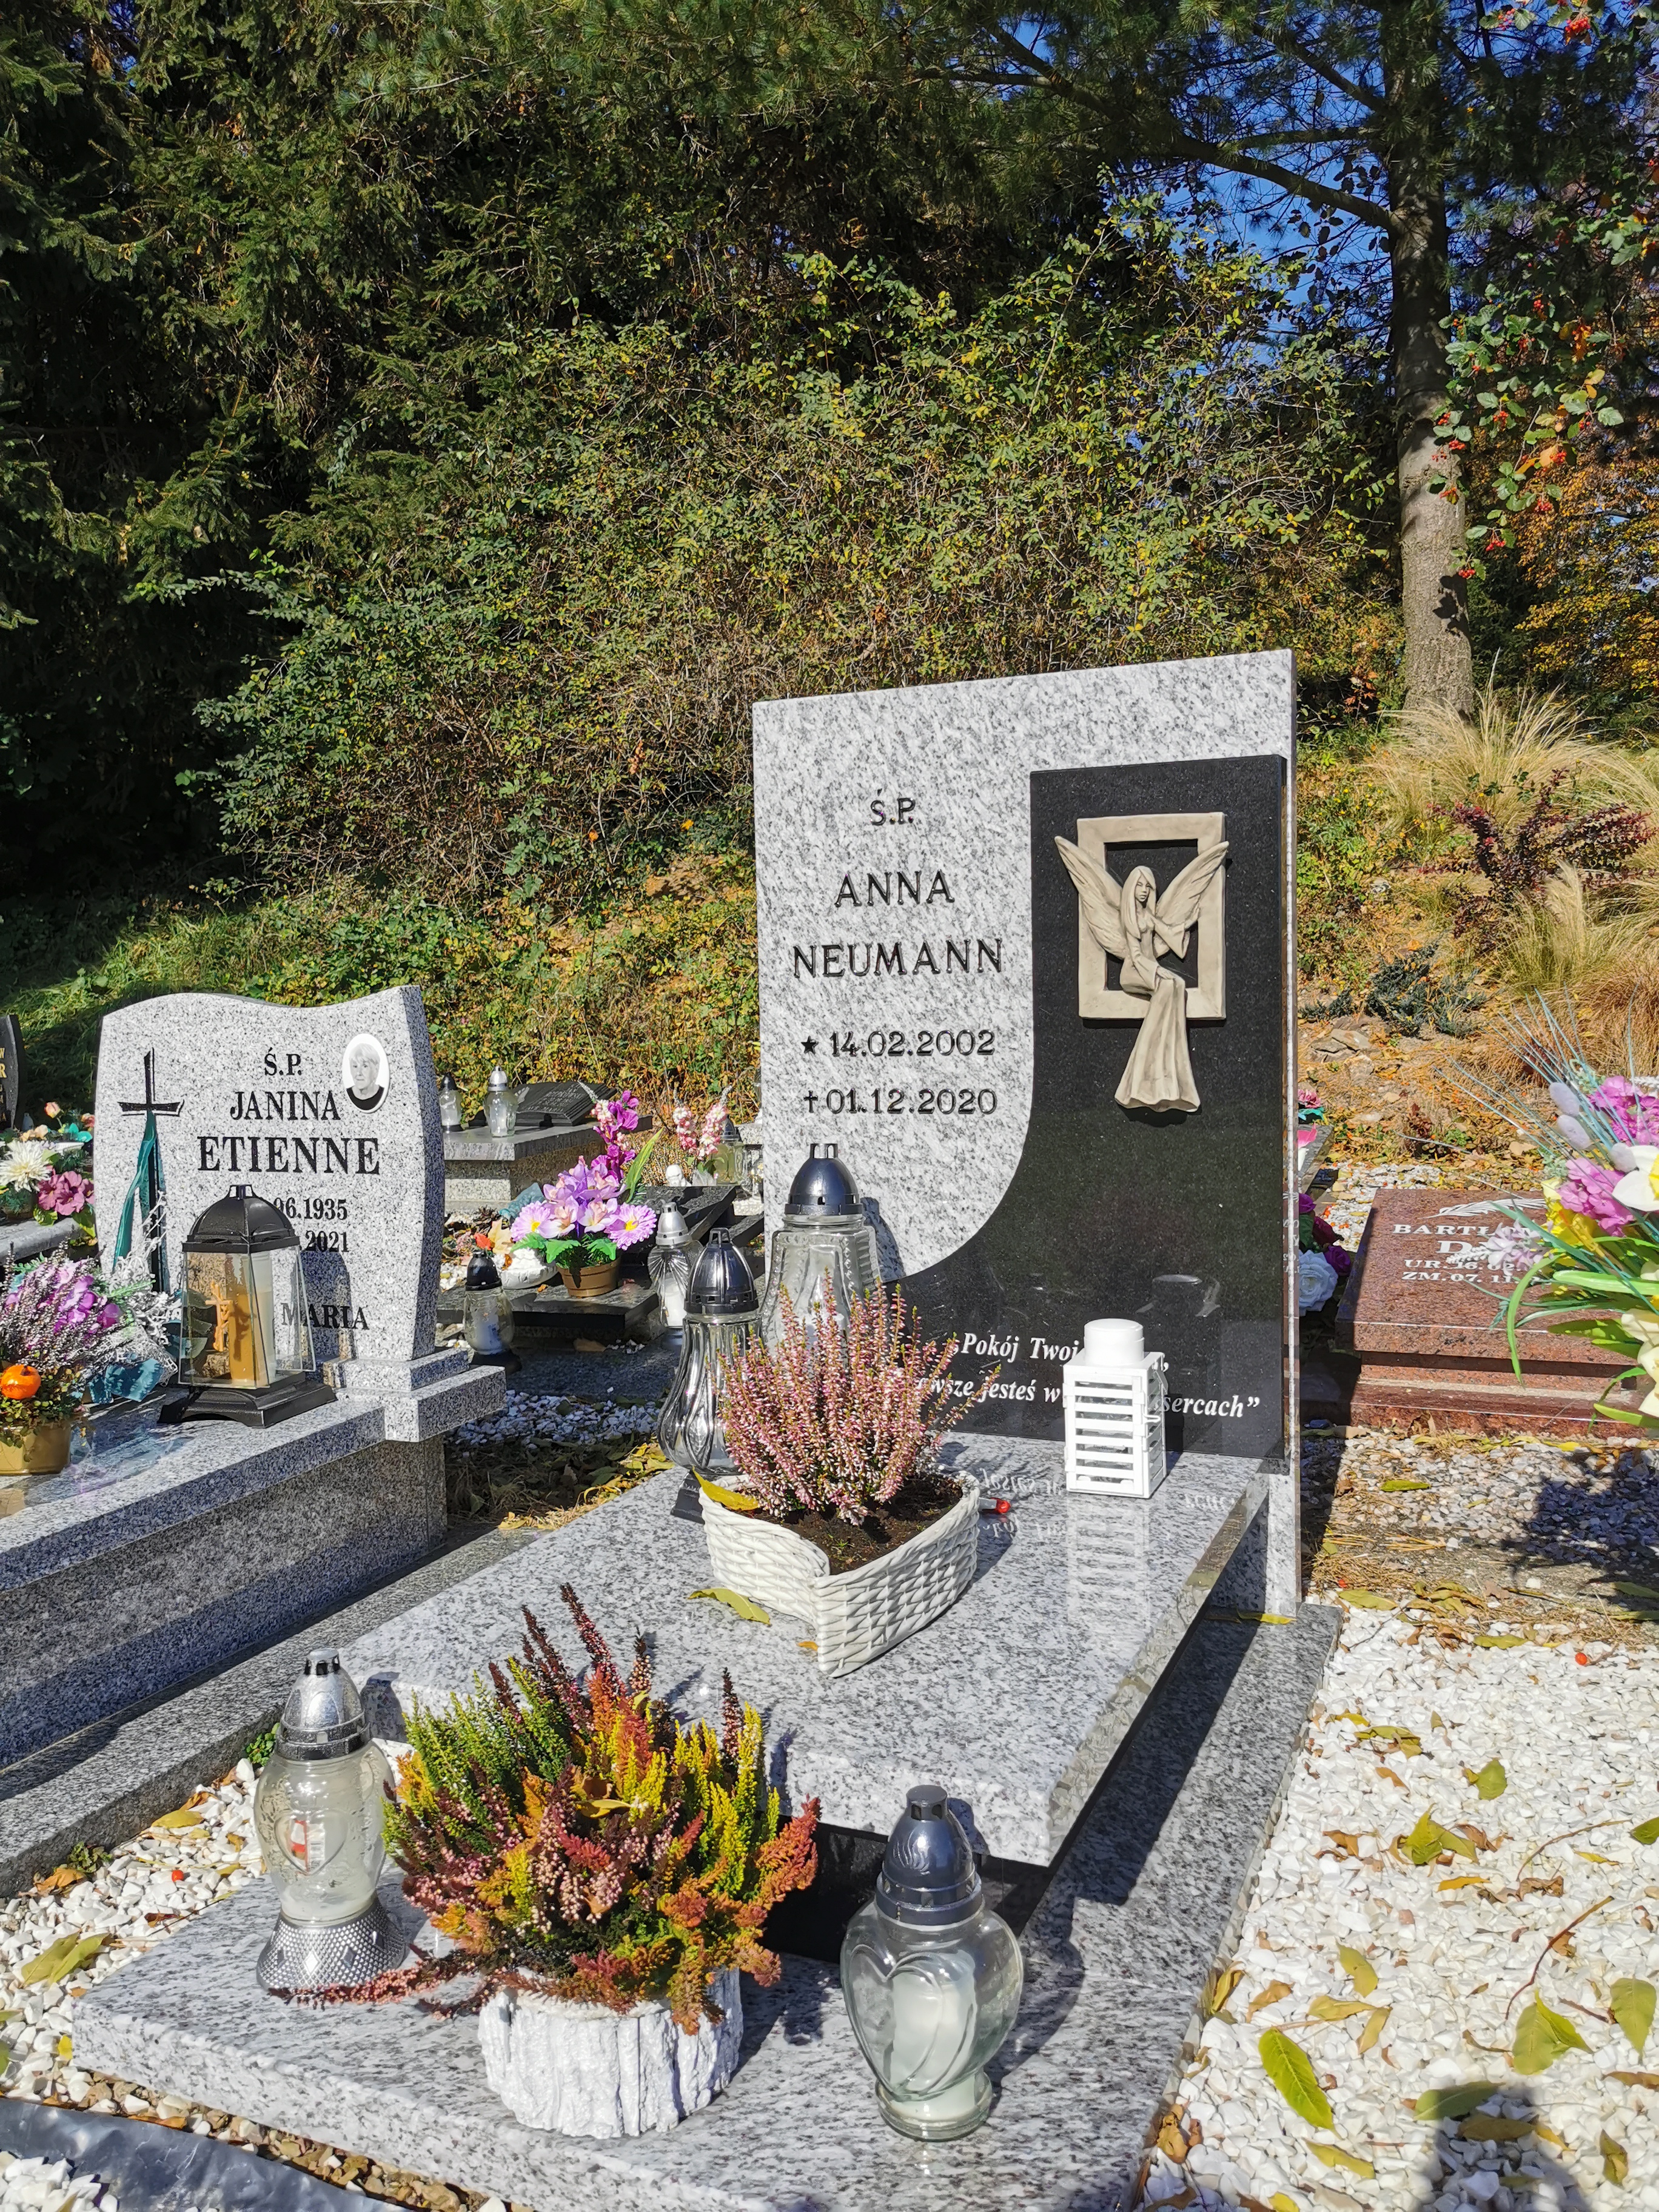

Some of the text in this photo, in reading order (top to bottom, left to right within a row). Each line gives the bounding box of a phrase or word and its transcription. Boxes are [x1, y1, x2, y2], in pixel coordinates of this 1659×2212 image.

[834, 869, 956, 908] ANNA
[793, 937, 1003, 978] NEUMANN
[829, 1030, 996, 1057] 14.02.2002
[264, 1047, 303, 1076] Ś.P.
[230, 1091, 341, 1121] JANINA
[825, 1088, 998, 1114] 01.12.2020
[196, 1136, 380, 1175] ETIENNE
[273, 1197, 348, 1220] 06.1935
[280, 1302, 370, 1330] MARIA
[977, 1376, 1037, 1403] jesteś
[1044, 1386, 1061, 1404] w
